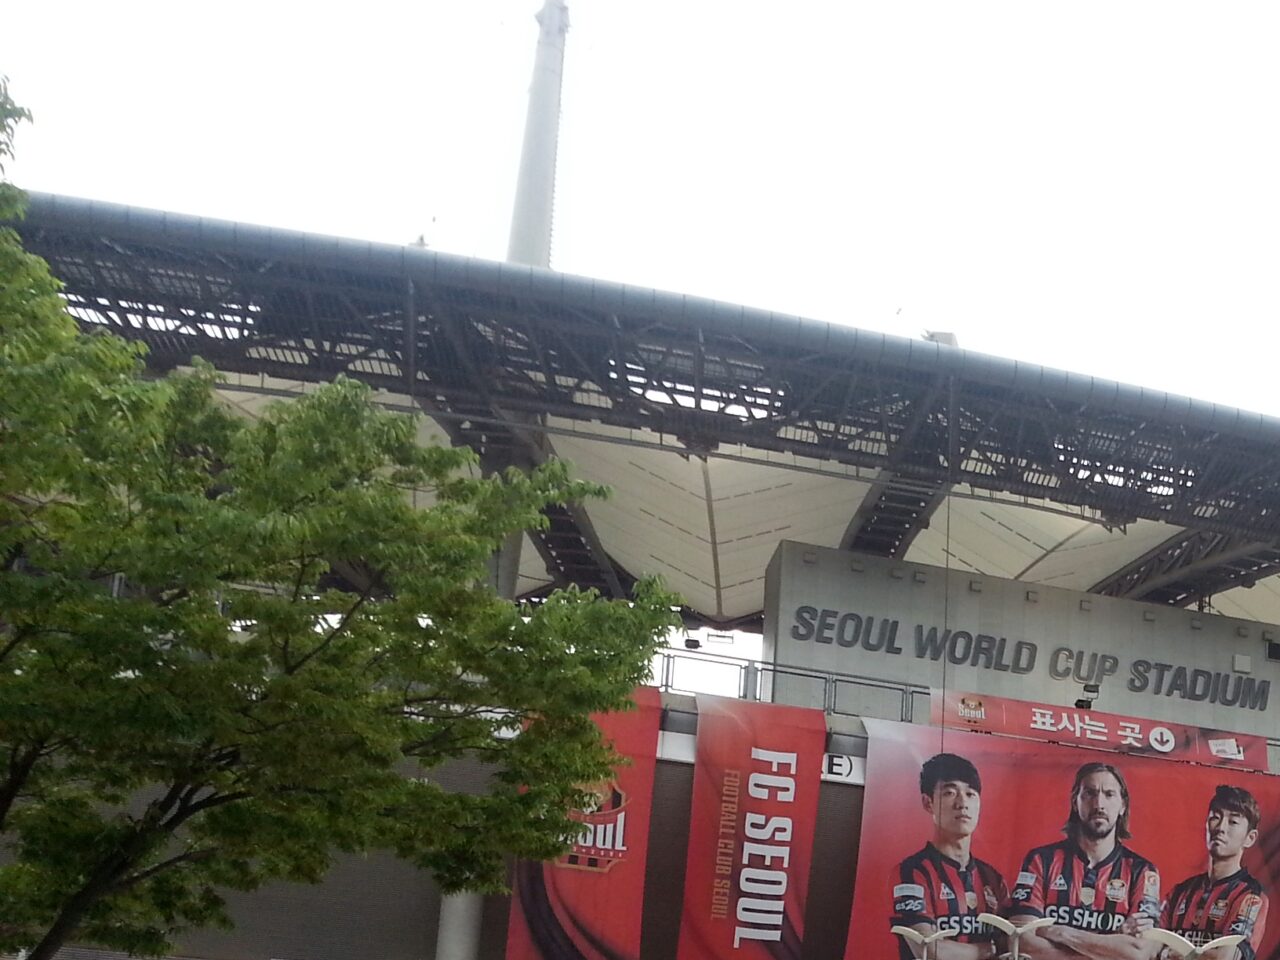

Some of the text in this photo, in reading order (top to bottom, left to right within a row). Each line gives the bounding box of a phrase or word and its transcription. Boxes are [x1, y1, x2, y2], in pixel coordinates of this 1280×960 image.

[792, 605, 1270, 712] SEOUL WORLD CUP STADIUM
[1030, 708, 1143, 746] 표사는 곳
[711, 769, 741, 920] FOOTBALL CLUB SEOUL
[733, 747, 797, 948] FC SEOUL
[1045, 905, 1125, 931] GS SHOP
